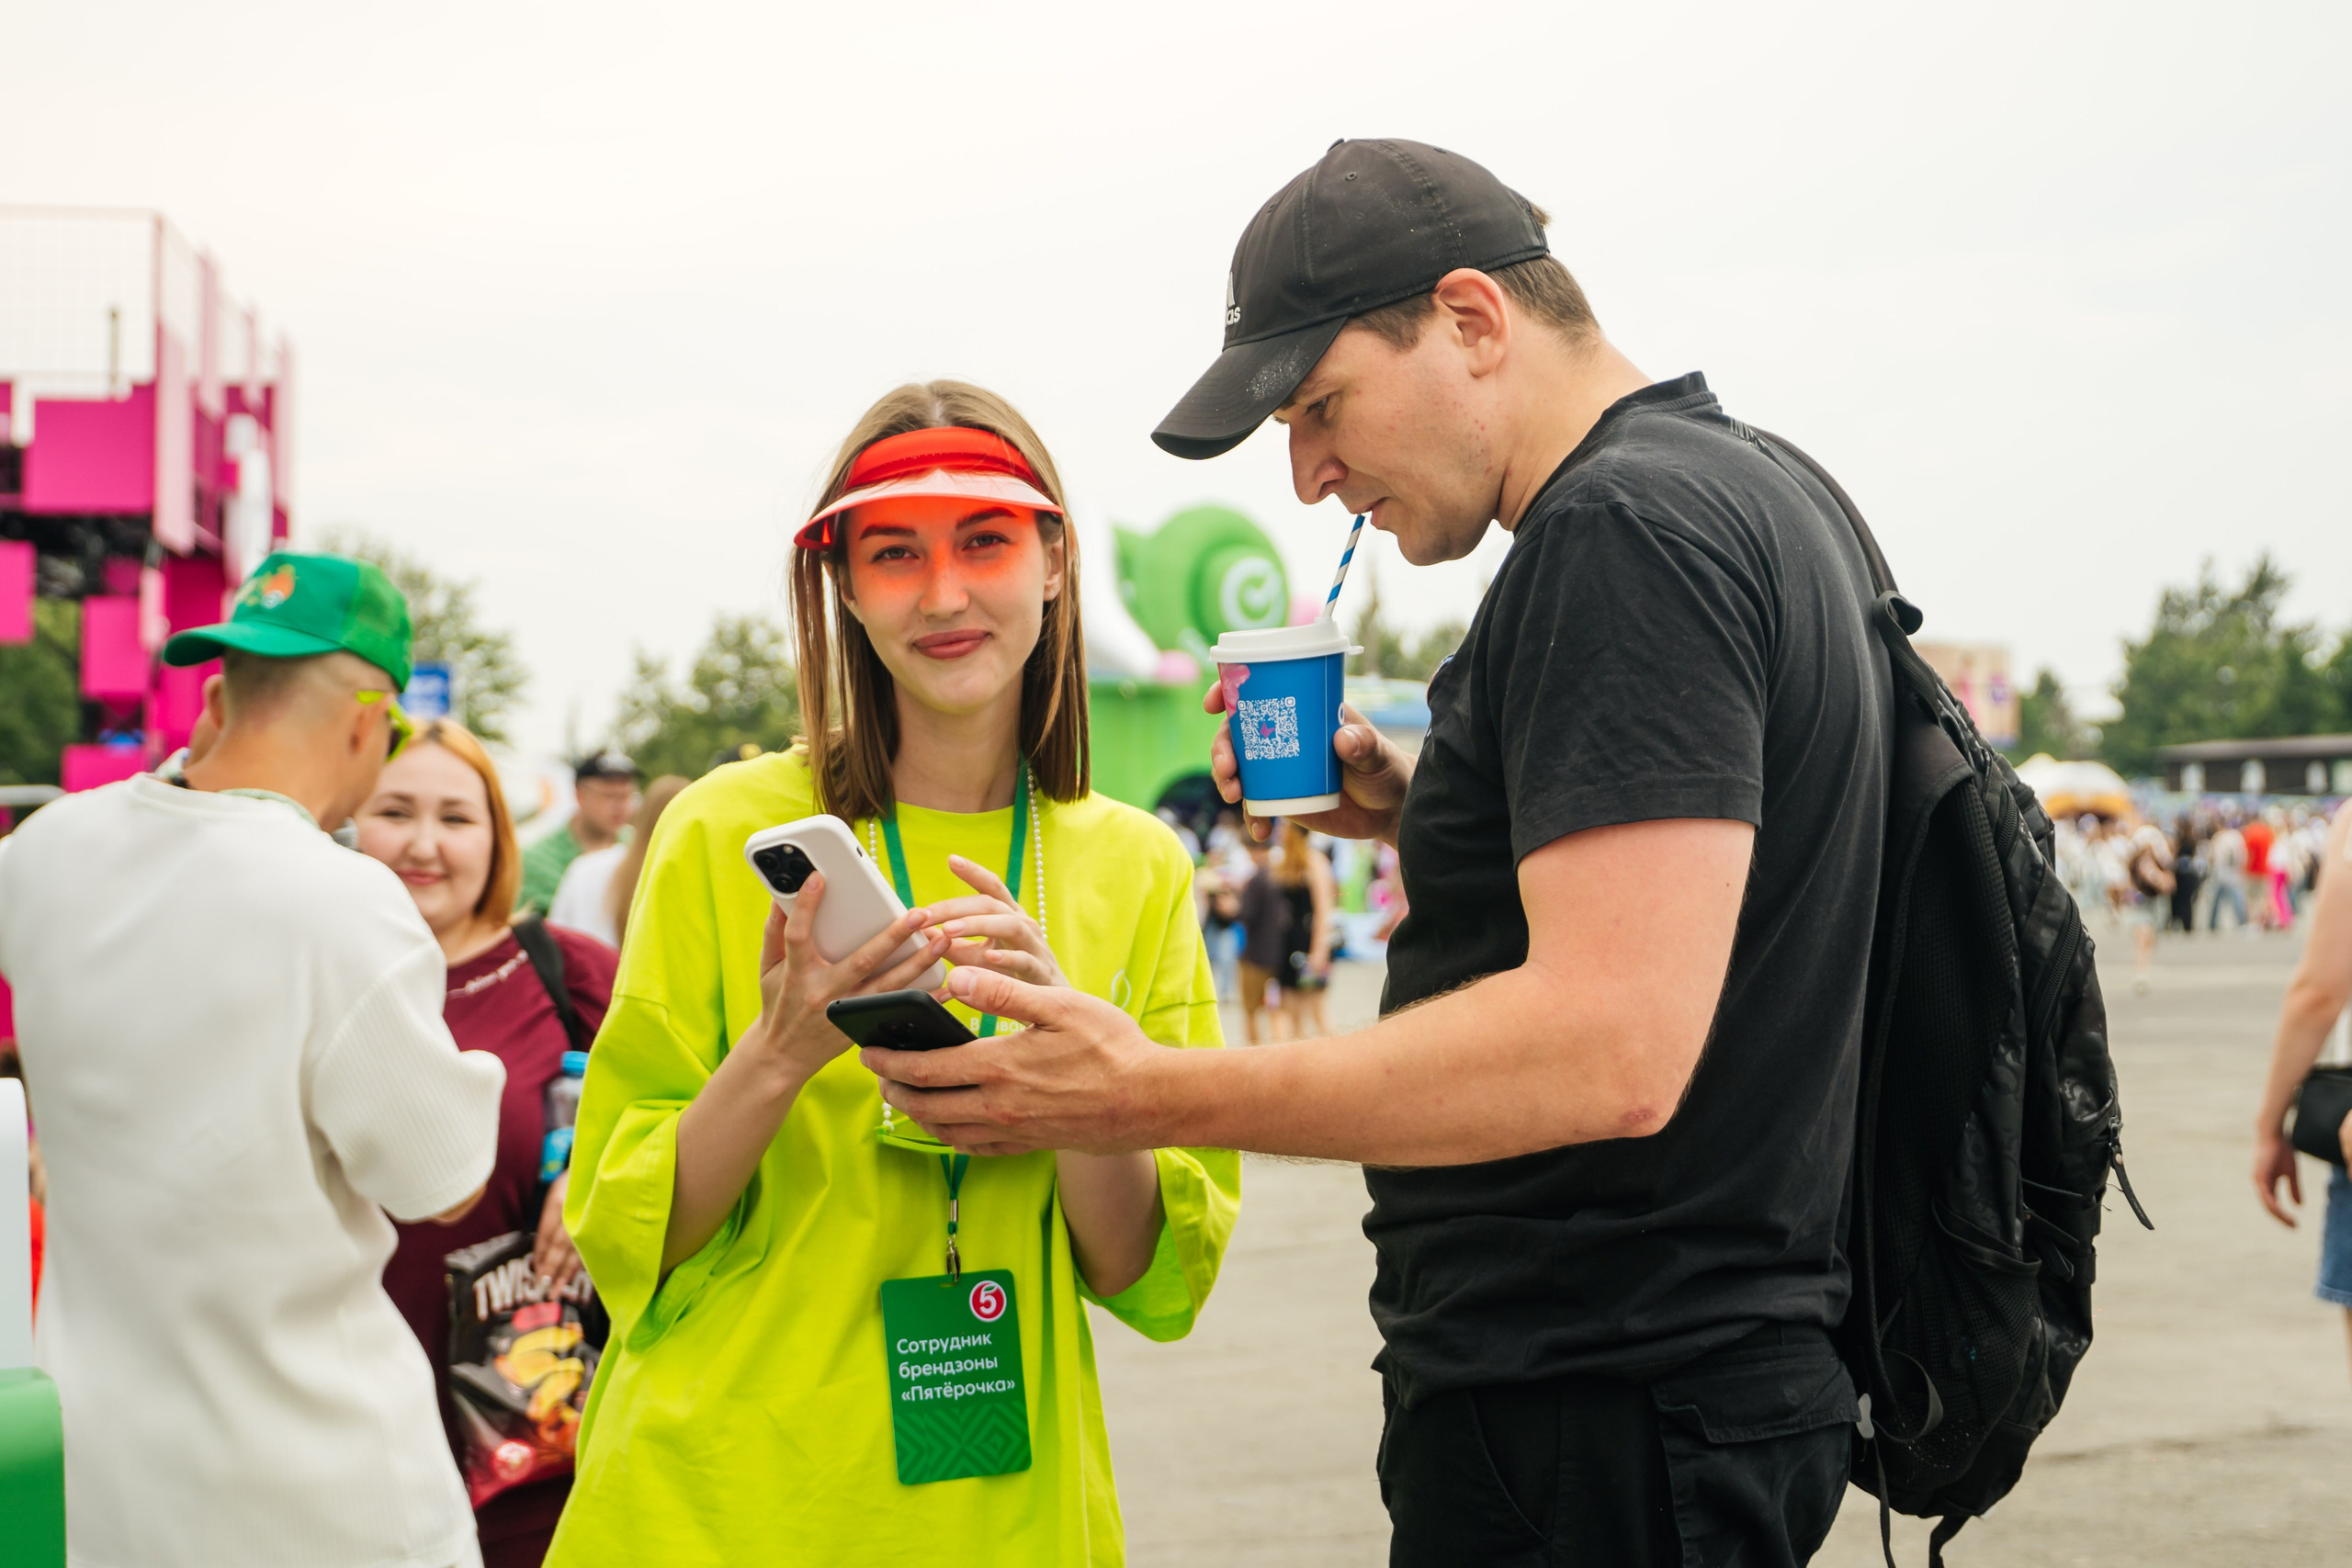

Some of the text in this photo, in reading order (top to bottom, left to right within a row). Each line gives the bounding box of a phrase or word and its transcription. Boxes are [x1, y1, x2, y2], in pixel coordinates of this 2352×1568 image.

[978, 1284, 999, 1314] 5
[896, 1332, 993, 1355] Сотрудник
[899, 1356, 999, 1381] брендзоны
[901, 1379, 1016, 1402] «Пятёрочка»
